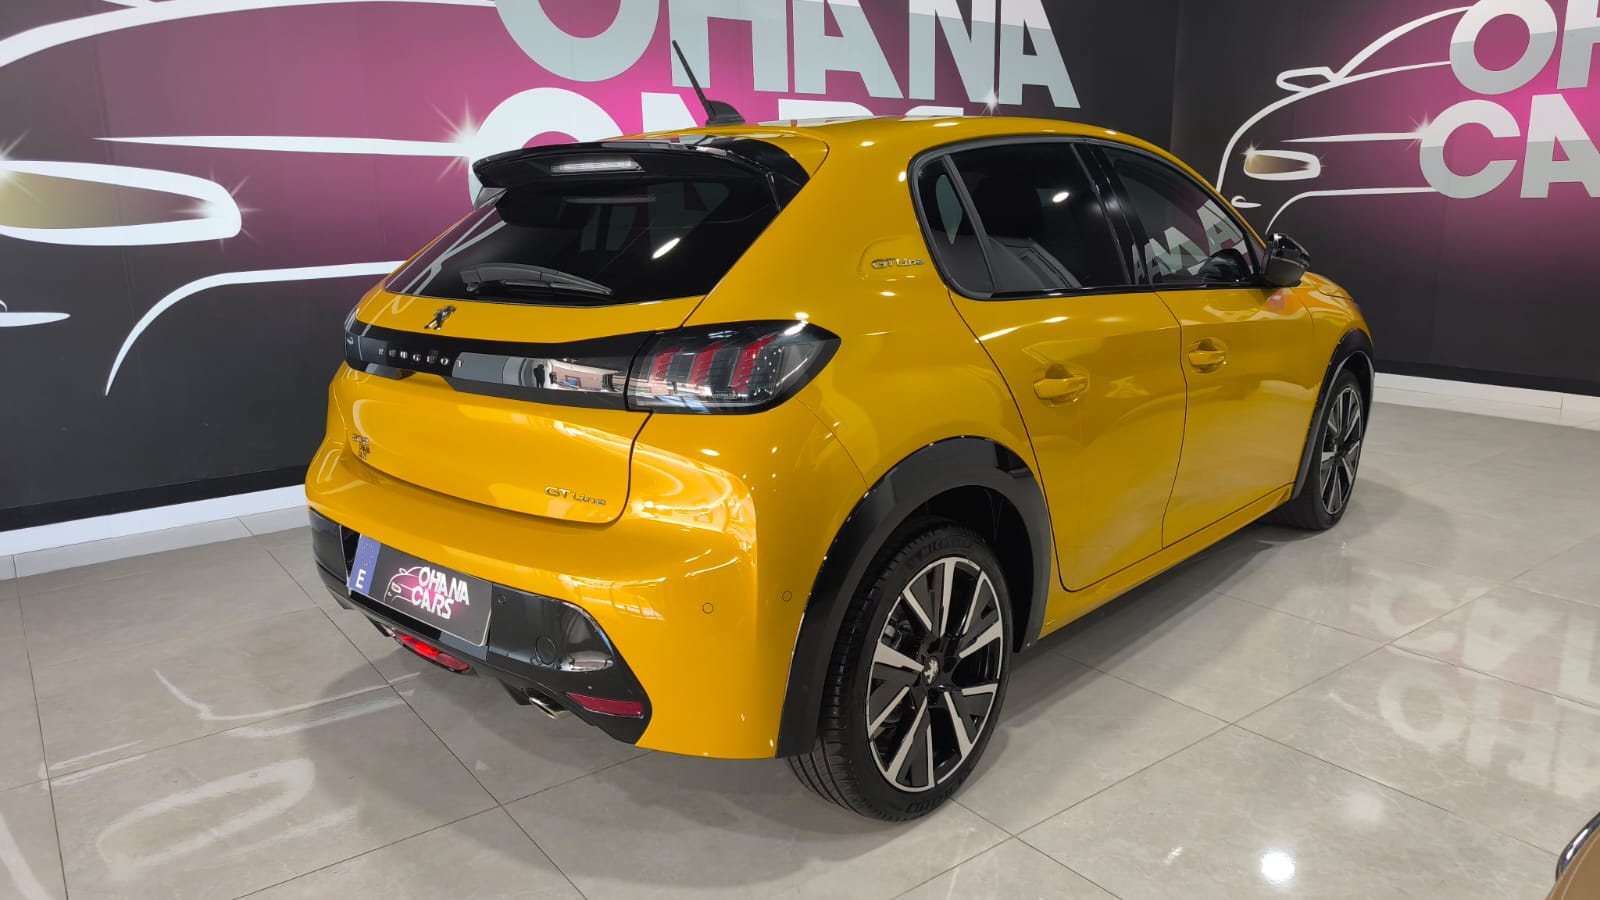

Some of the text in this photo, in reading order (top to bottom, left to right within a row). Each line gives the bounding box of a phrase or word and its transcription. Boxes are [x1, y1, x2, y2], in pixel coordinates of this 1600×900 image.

[545, 486, 571, 499] GT
[355, 569, 367, 590] E
[418, 566, 470, 606] OHANA
[411, 586, 455, 620] CARS
